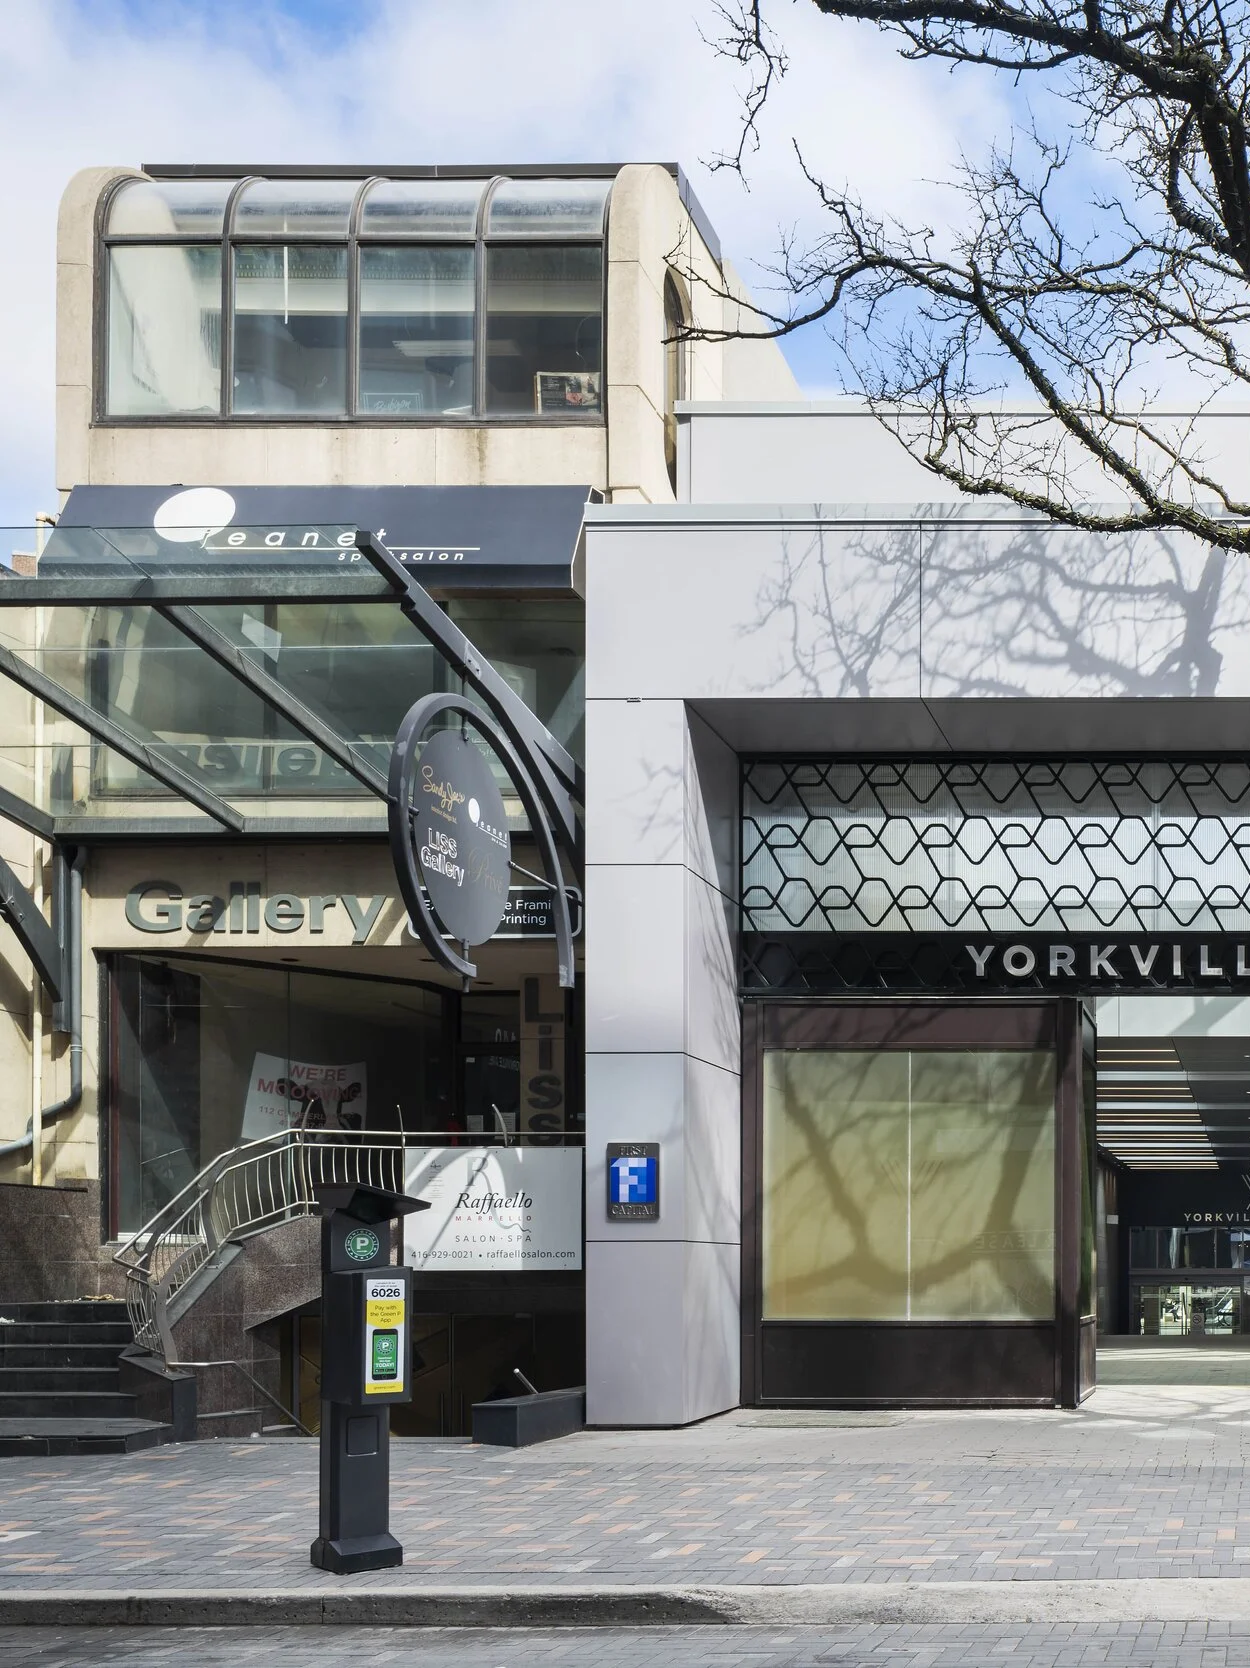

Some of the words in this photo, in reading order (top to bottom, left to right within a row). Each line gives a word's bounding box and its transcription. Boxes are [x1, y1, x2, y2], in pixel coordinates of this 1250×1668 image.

[400, 551, 464, 561] salon
[421, 845, 465, 887] Gallery
[515, 899, 551, 911] Frami
[125, 879, 388, 946] Gallery
[500, 914, 547, 926] Printing
[290, 1064, 347, 1082] WE'RE
[259, 1105, 274, 1115] 112
[620, 1145, 648, 1156] FIRST
[455, 1192, 533, 1215] Raffaello
[612, 1205, 656, 1215] CAPITAL
[356, 1237, 370, 1250] P
[455, 1235, 496, 1243] SALON
[507, 1235, 532, 1243] SPA
[411, 1250, 473, 1259] 416-929-0021
[486, 1249, 576, 1259] raffaellosalon.com
[371, 1288, 400, 1298] 6026
